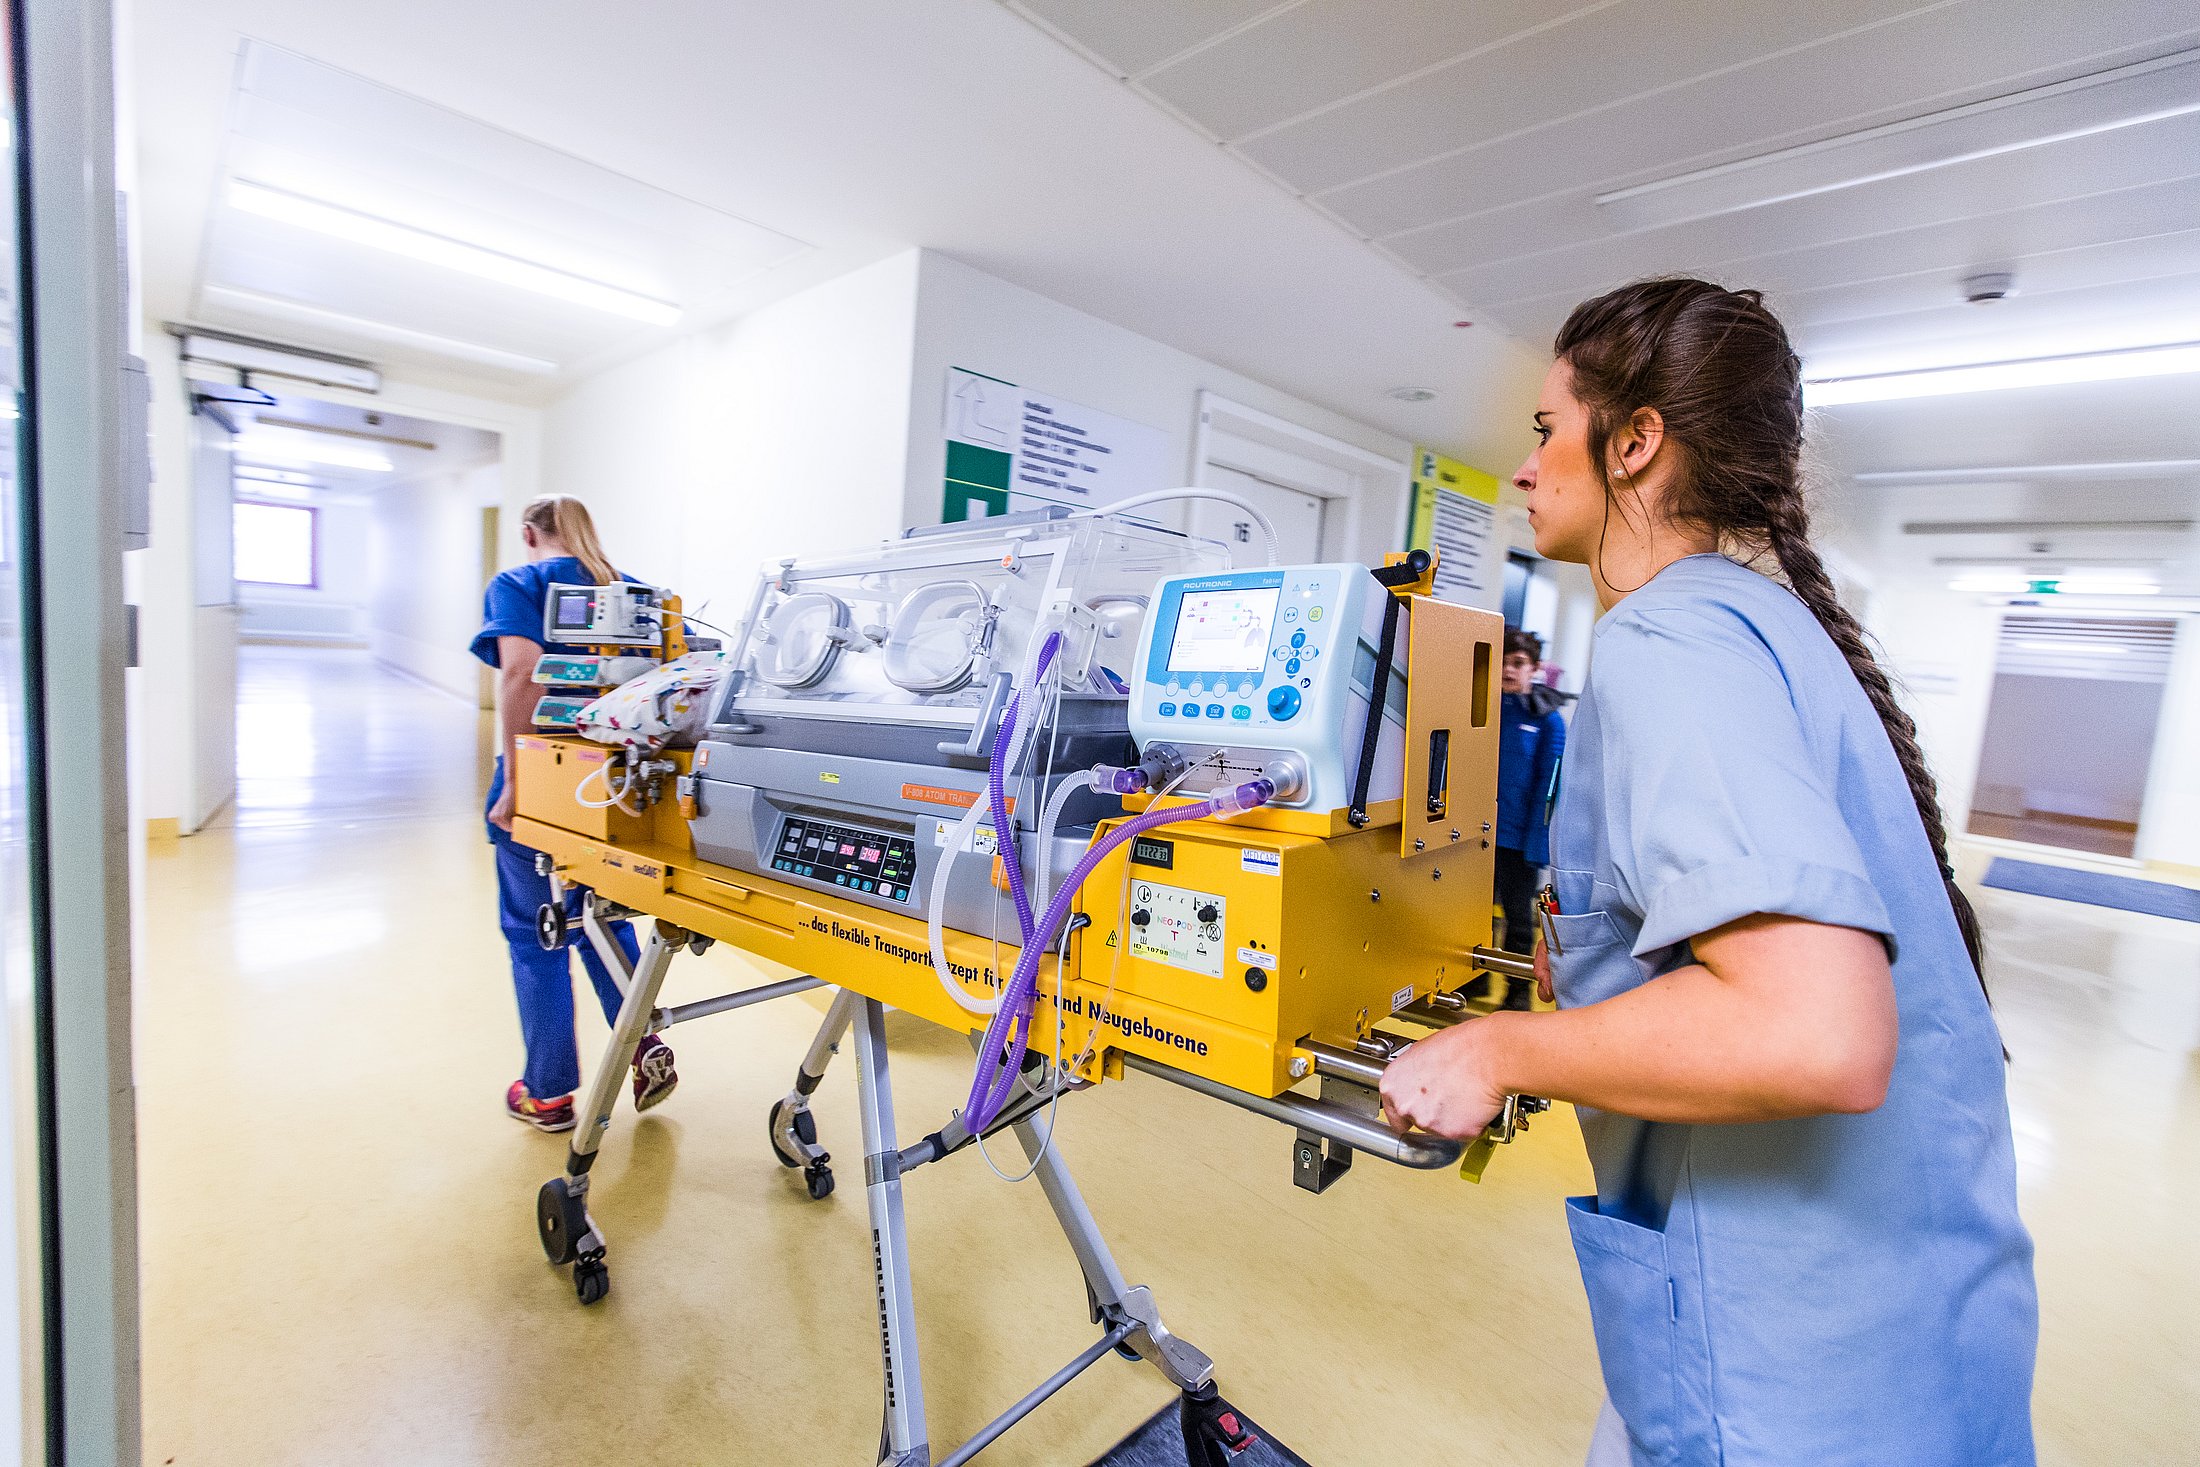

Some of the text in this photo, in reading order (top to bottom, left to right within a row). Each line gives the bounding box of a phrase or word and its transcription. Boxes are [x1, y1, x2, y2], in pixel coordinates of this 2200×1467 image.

[1183, 580, 1232, 589] ACUTRONIC
[925, 790, 946, 801] ATOM
[1171, 930, 1179, 941] T
[832, 921, 870, 948] flexible
[874, 934, 978, 984] Transportknzept
[983, 967, 1004, 990] für
[1147, 946, 1168, 956] 10798
[1053, 994, 1208, 1057] und Neugeborene
